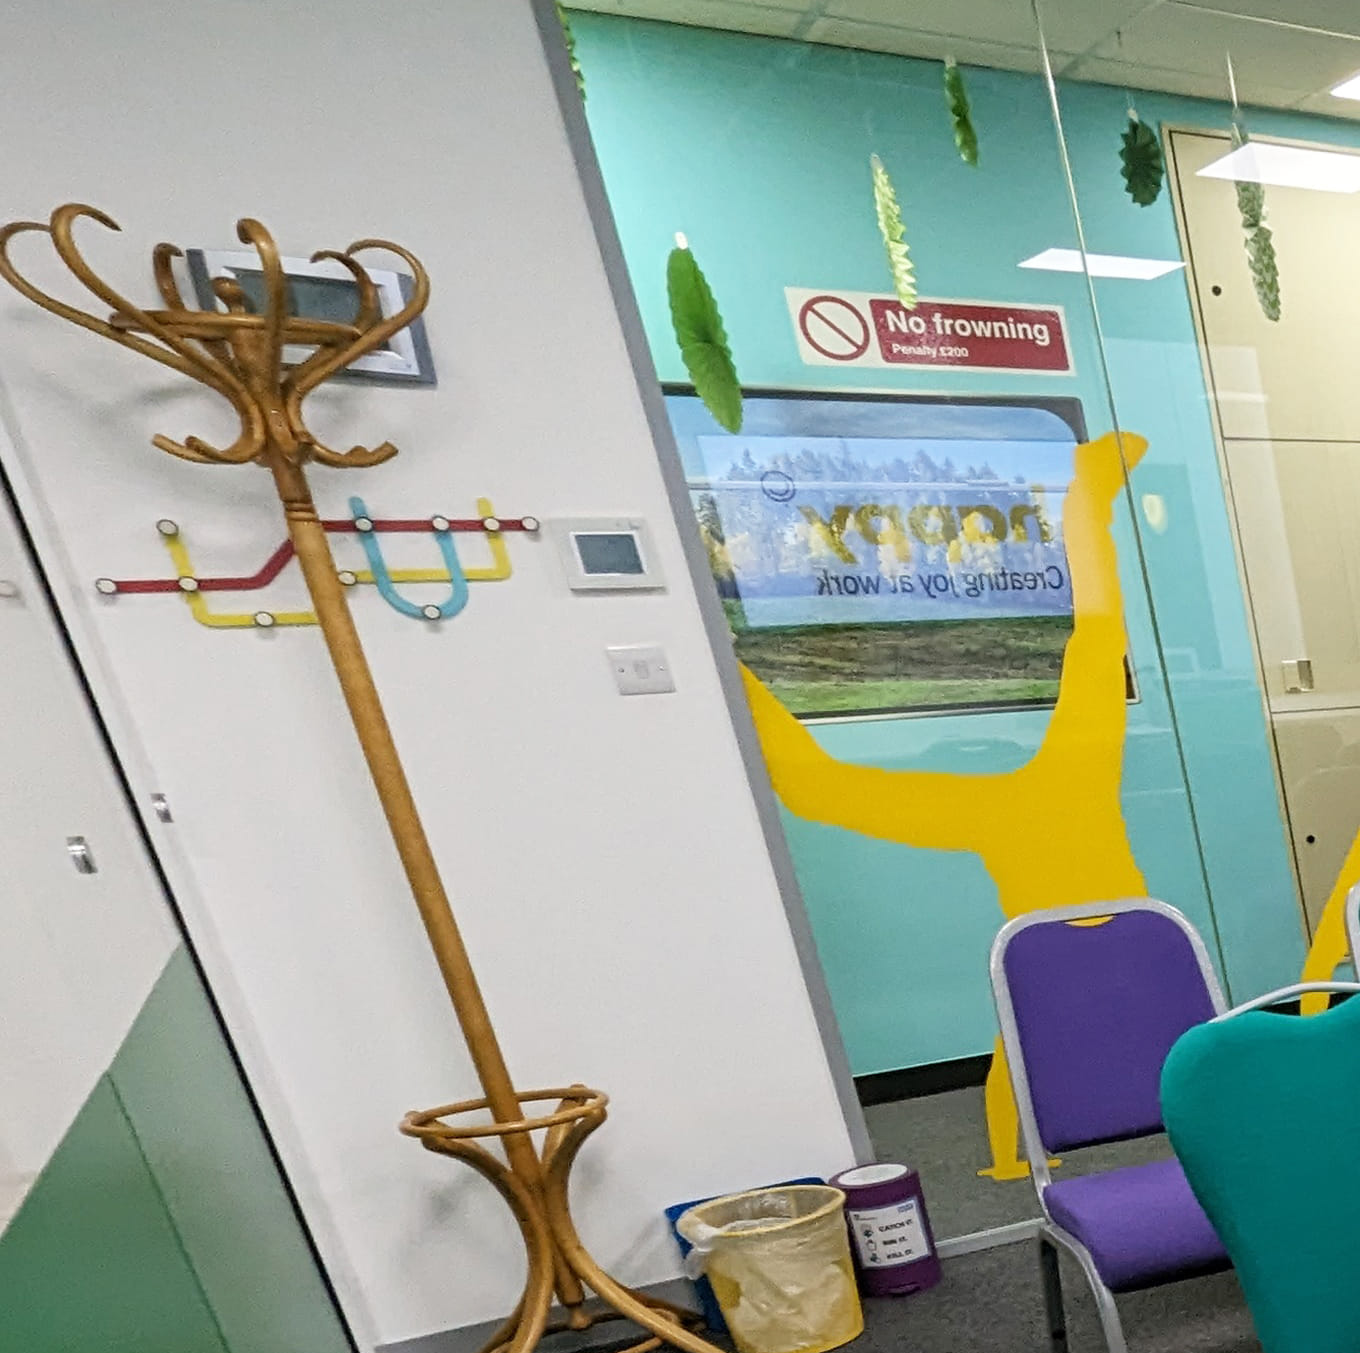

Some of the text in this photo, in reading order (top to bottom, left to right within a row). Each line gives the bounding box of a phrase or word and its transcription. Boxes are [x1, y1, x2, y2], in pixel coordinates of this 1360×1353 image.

[885, 310, 1050, 346] No frowning
[892, 343, 970, 358] Penalty £200
